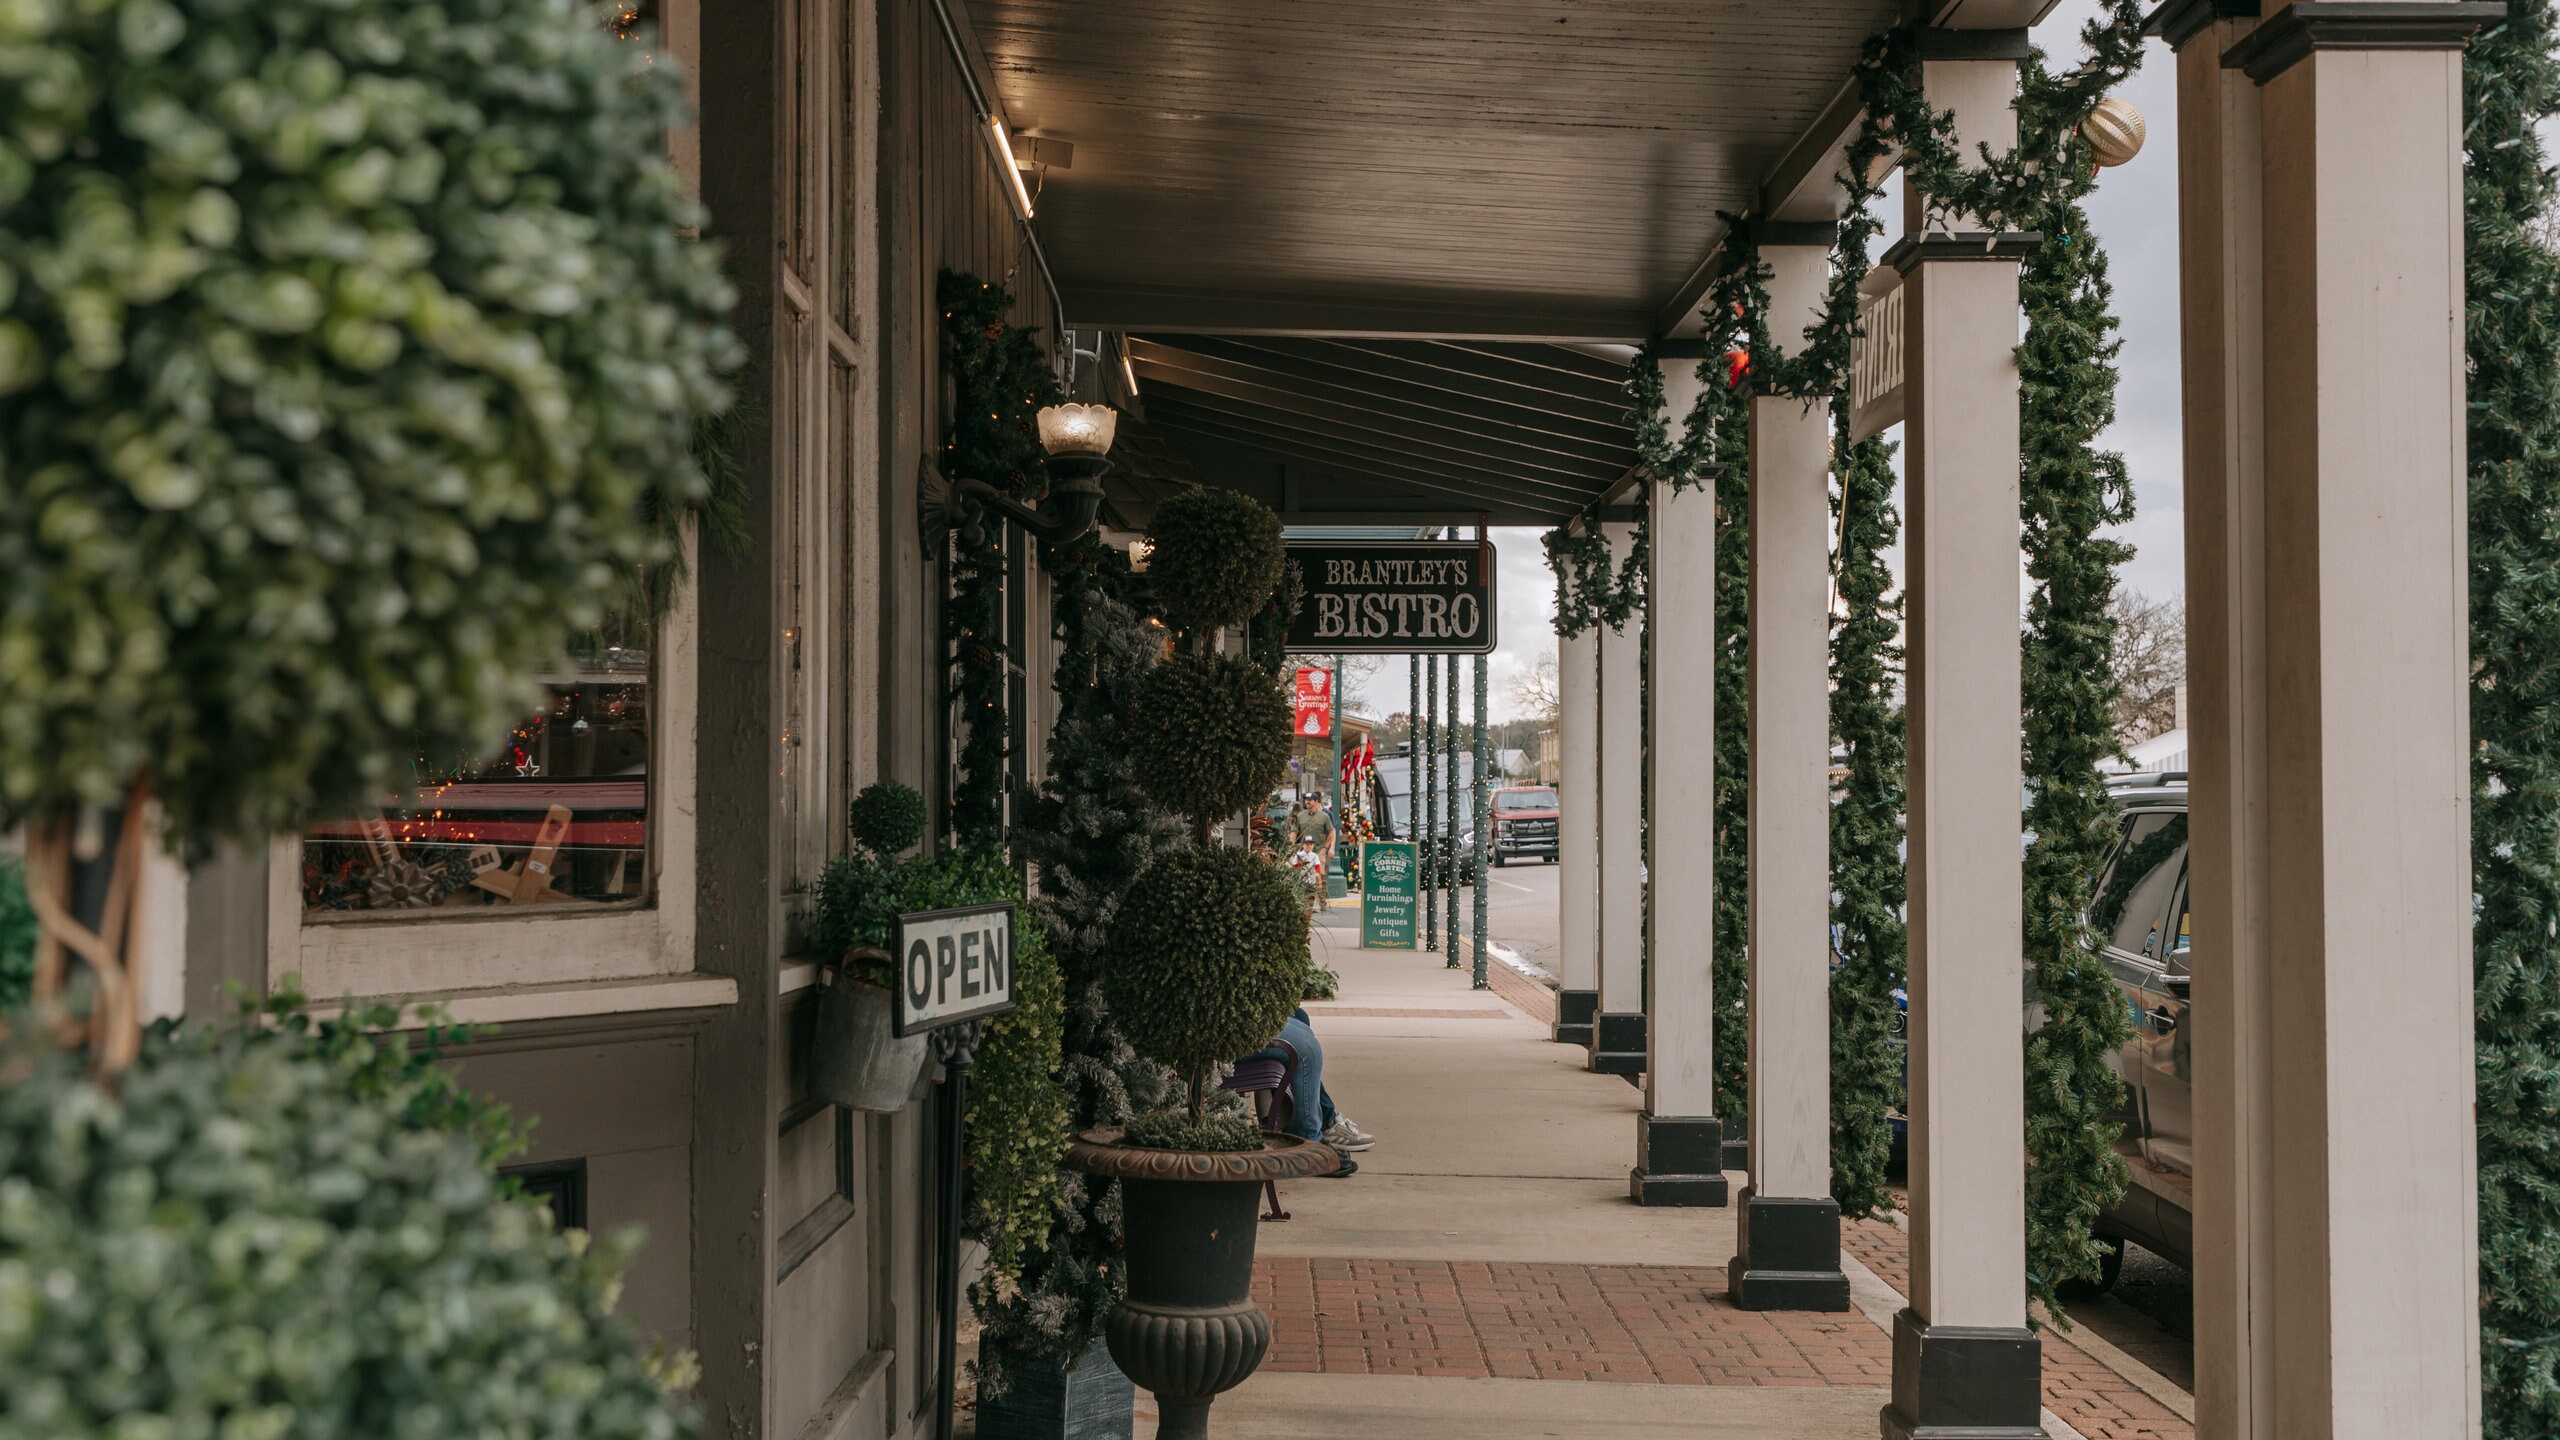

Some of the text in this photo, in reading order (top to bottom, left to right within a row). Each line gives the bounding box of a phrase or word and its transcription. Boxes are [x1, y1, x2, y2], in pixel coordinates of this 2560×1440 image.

[1325, 559, 1467, 586] BRANTLEY'S
[1314, 593, 1480, 638] BISTRO
[1298, 690, 1327, 702] Season's
[1298, 699, 1329, 712] Greetings
[1374, 859, 1407, 868] CORNER
[1376, 865, 1405, 873] CARTEL
[1379, 885, 1401, 893] Home
[1366, 893, 1414, 904] Furnishings
[1374, 905, 1405, 916] Jewelry
[1372, 917, 1408, 926] Antiques
[1379, 928, 1400, 937] Gifts
[907, 927, 1004, 1010] OPEN
